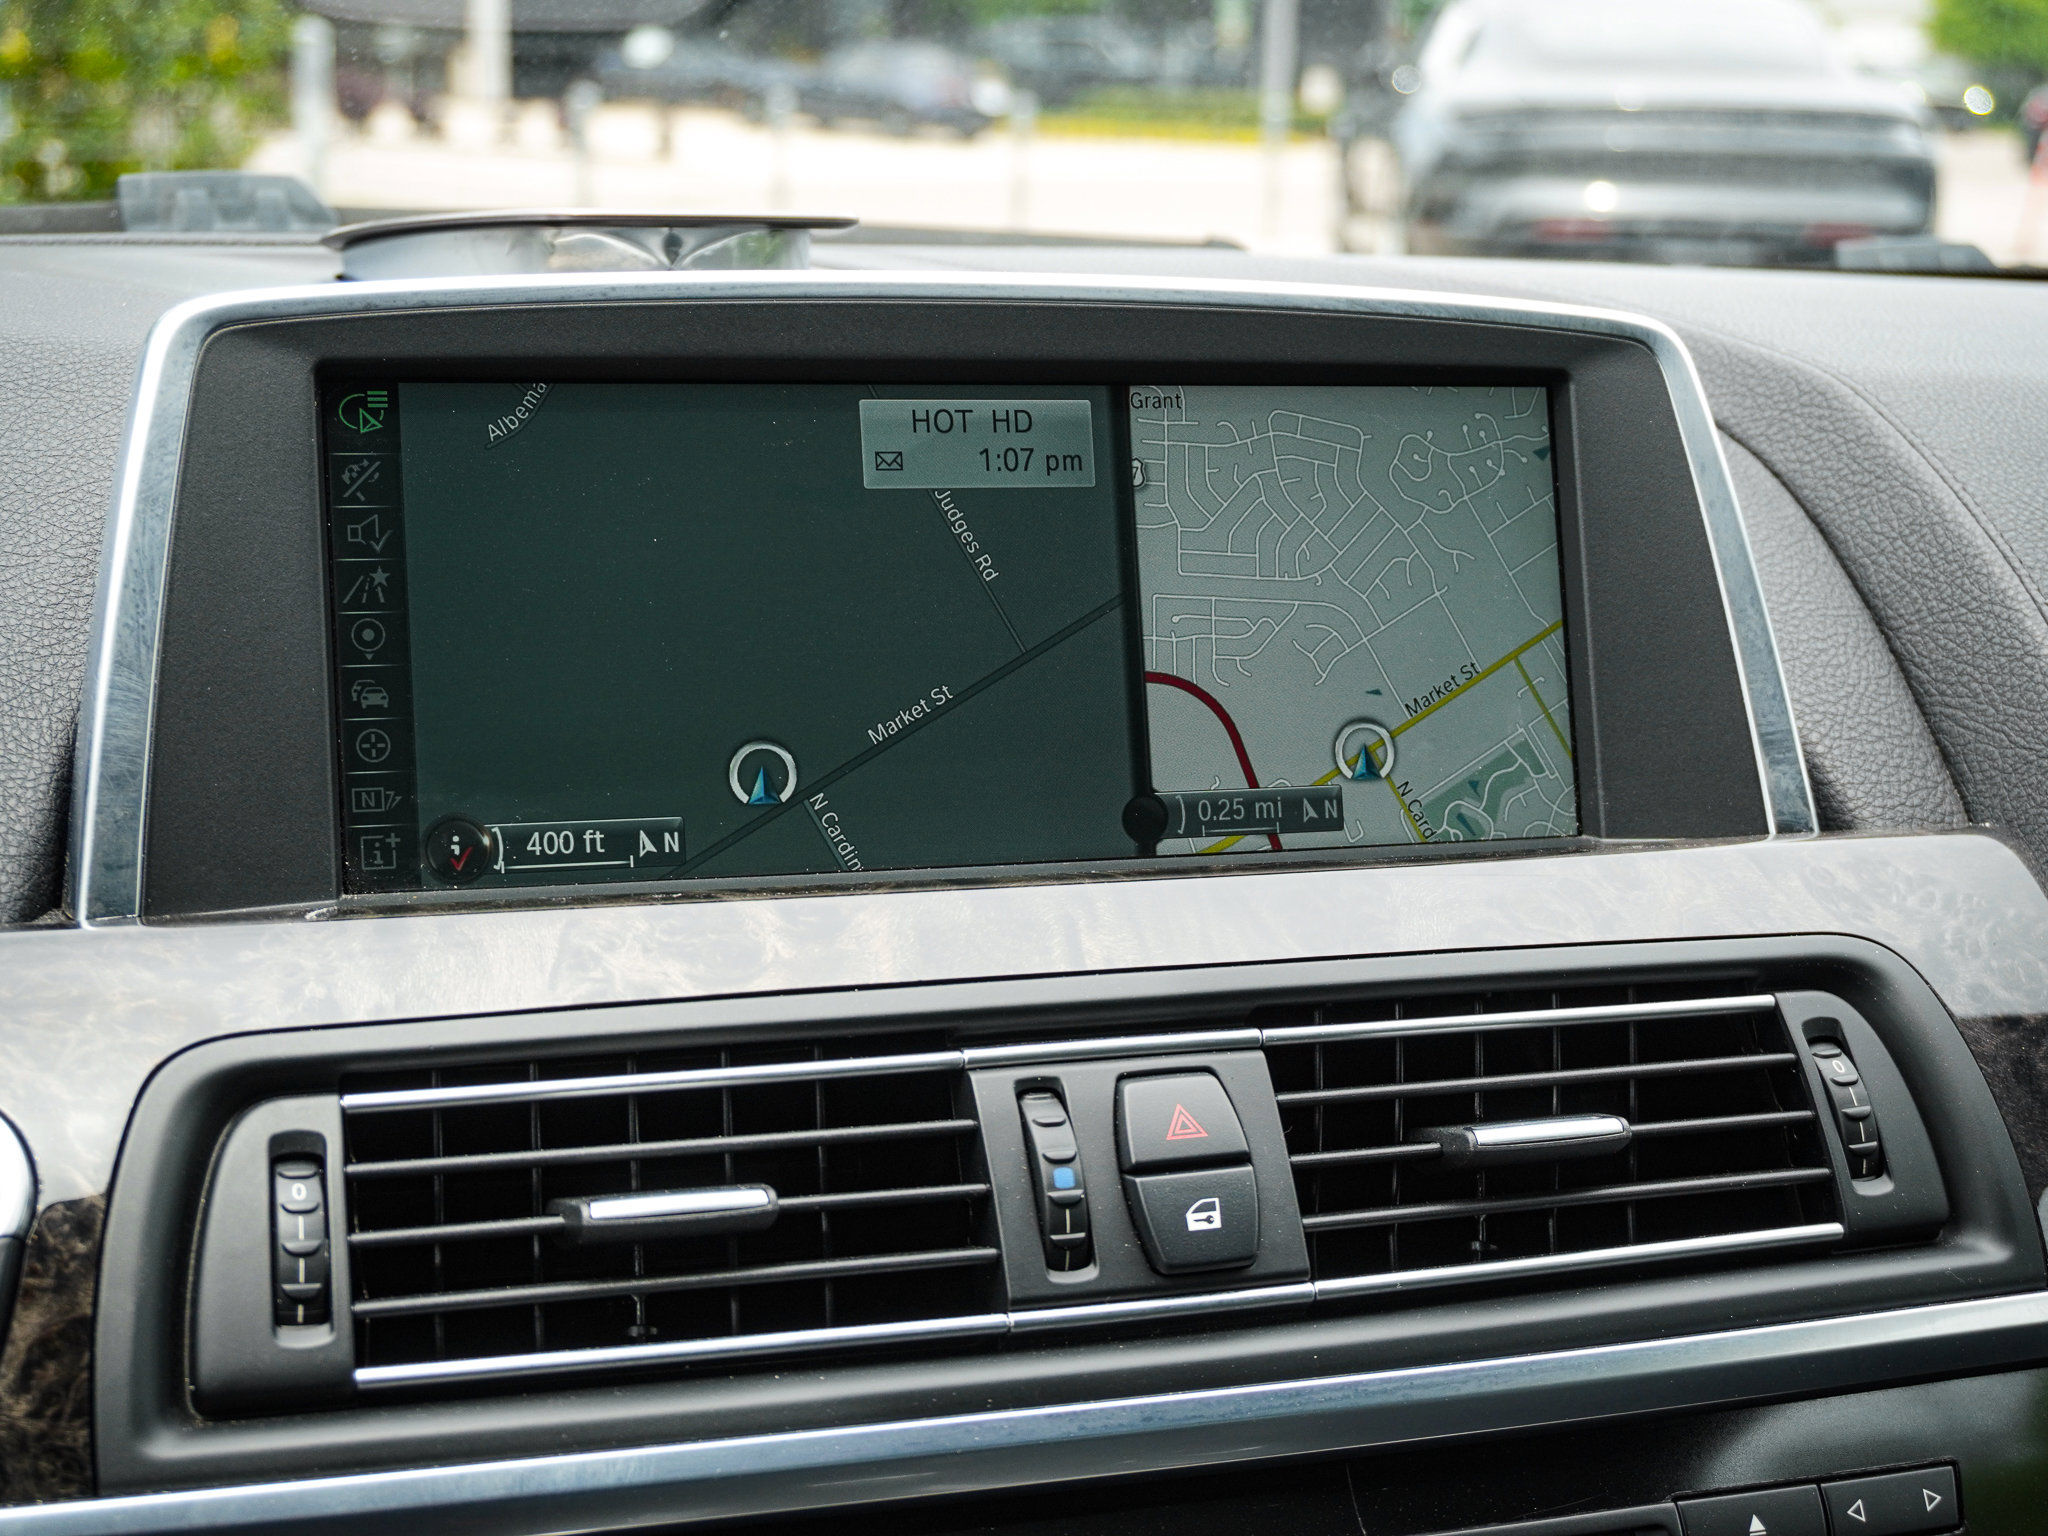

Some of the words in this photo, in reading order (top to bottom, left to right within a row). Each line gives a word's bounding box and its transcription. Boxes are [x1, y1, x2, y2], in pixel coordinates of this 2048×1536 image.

[1130, 391, 1182, 410] Grant
[912, 409, 974, 434] HOT
[992, 409, 1033, 433] HD
[979, 447, 1035, 472] 1:07
[1046, 454, 1083, 476] pm
[934, 490, 980, 554] Judges
[975, 554, 999, 582] Rd
[1405, 672, 1461, 718] Market
[1459, 661, 1481, 682] St
[867, 698, 932, 745] Market
[930, 684, 953, 706] St
[809, 792, 829, 811] N
[1198, 799, 1245, 822] 0.25
[1255, 798, 1283, 821] mi
[1324, 800, 1338, 818] N
[1396, 780, 1414, 797] N
[1407, 799, 1441, 841] Card
[526, 831, 575, 857] 400
[583, 829, 605, 853] ft
[664, 831, 680, 853] N
